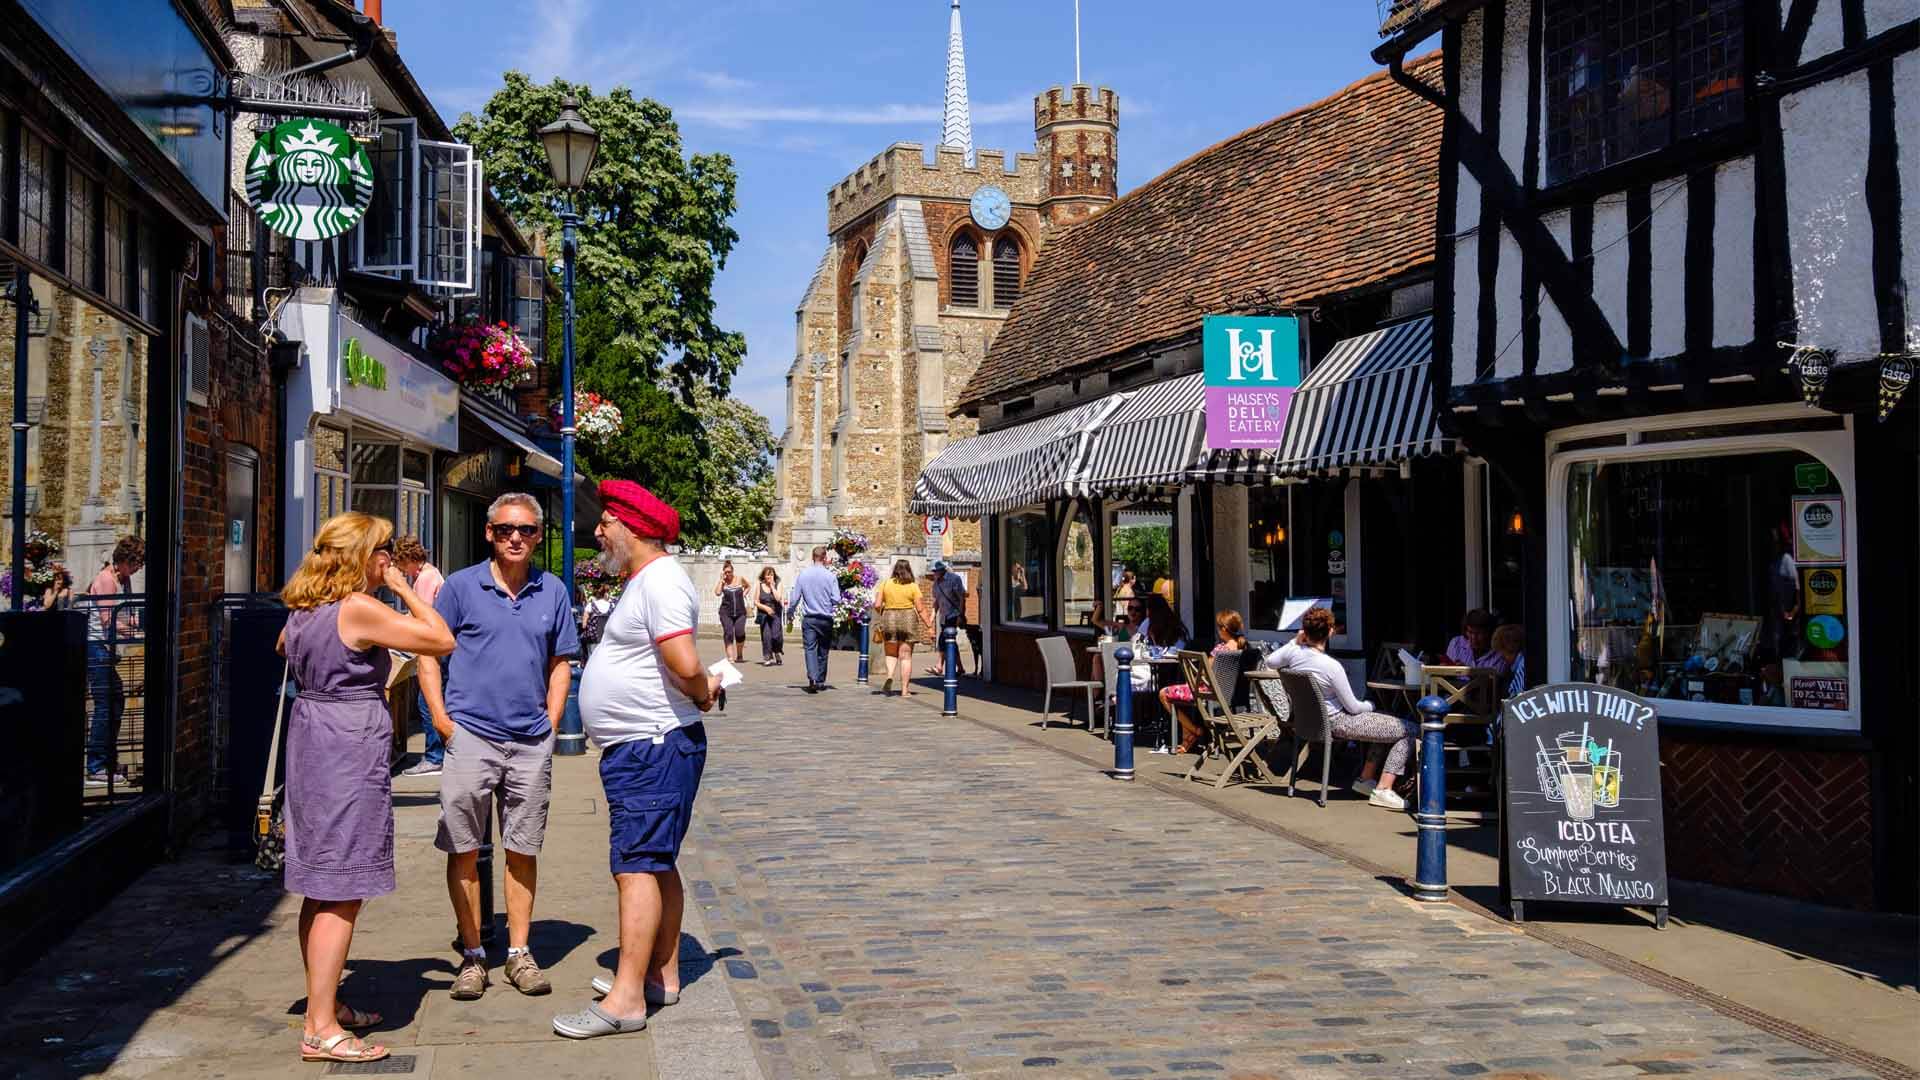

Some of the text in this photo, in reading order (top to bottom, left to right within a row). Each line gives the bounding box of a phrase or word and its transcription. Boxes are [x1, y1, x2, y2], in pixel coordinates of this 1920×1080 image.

[1801, 364, 1828, 376] taste
[1882, 367, 1911, 383] taste
[1227, 392, 1280, 406] HALSEY'S
[1228, 406, 1266, 419] DELI
[1229, 419, 1281, 433] EATERY
[1512, 689, 1654, 730] ICE WITH THAT?
[1558, 820, 1636, 845] ICED TEA
[1516, 836, 1637, 872] Summer Berries
[1543, 871, 1597, 896] BLACK
